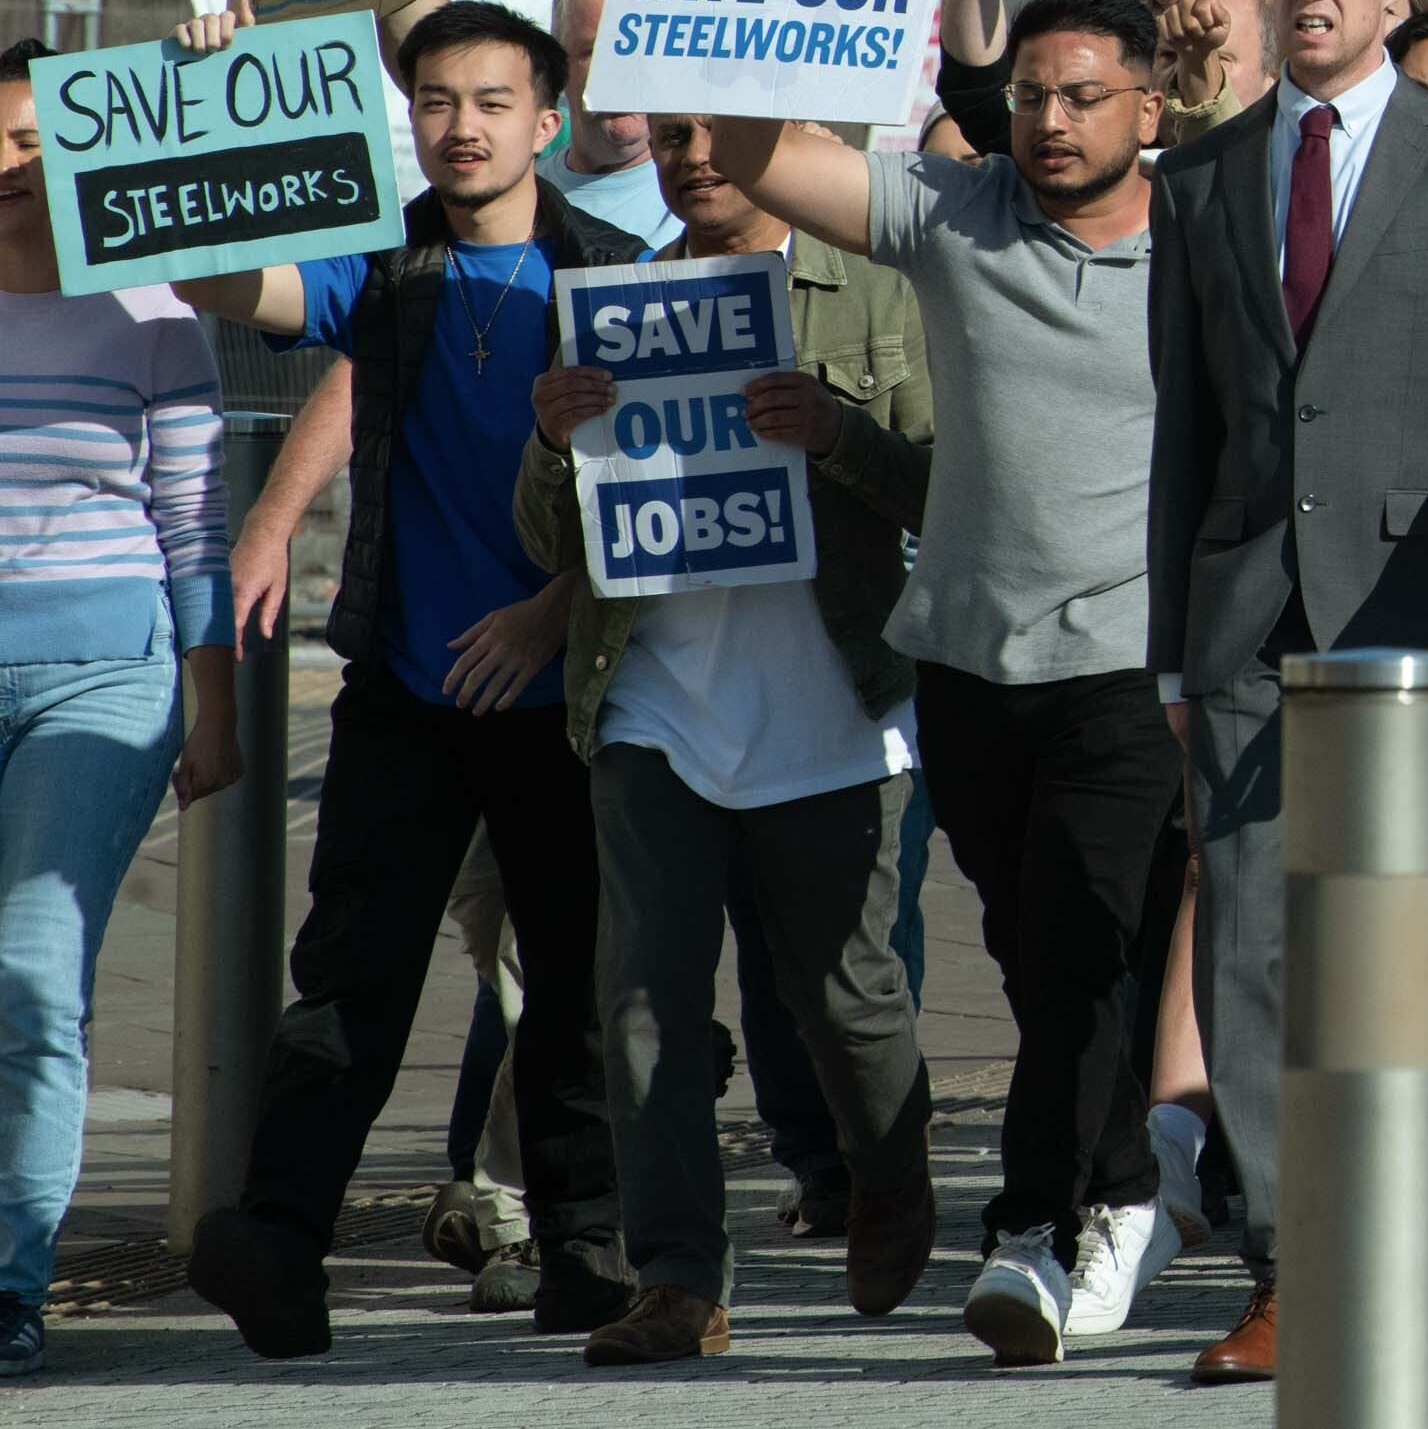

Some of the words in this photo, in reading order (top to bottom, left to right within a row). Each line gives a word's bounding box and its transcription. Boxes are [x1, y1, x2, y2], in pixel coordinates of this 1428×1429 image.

[614, 13, 904, 70] STEELWORKS!
[55, 60, 208, 152] SAVE
[226, 41, 364, 127] OUR
[103, 169, 360, 248] STEELWORKS
[593, 294, 756, 363] SAVE
[614, 393, 757, 460] OUR
[612, 490, 785, 559] JOBS!
